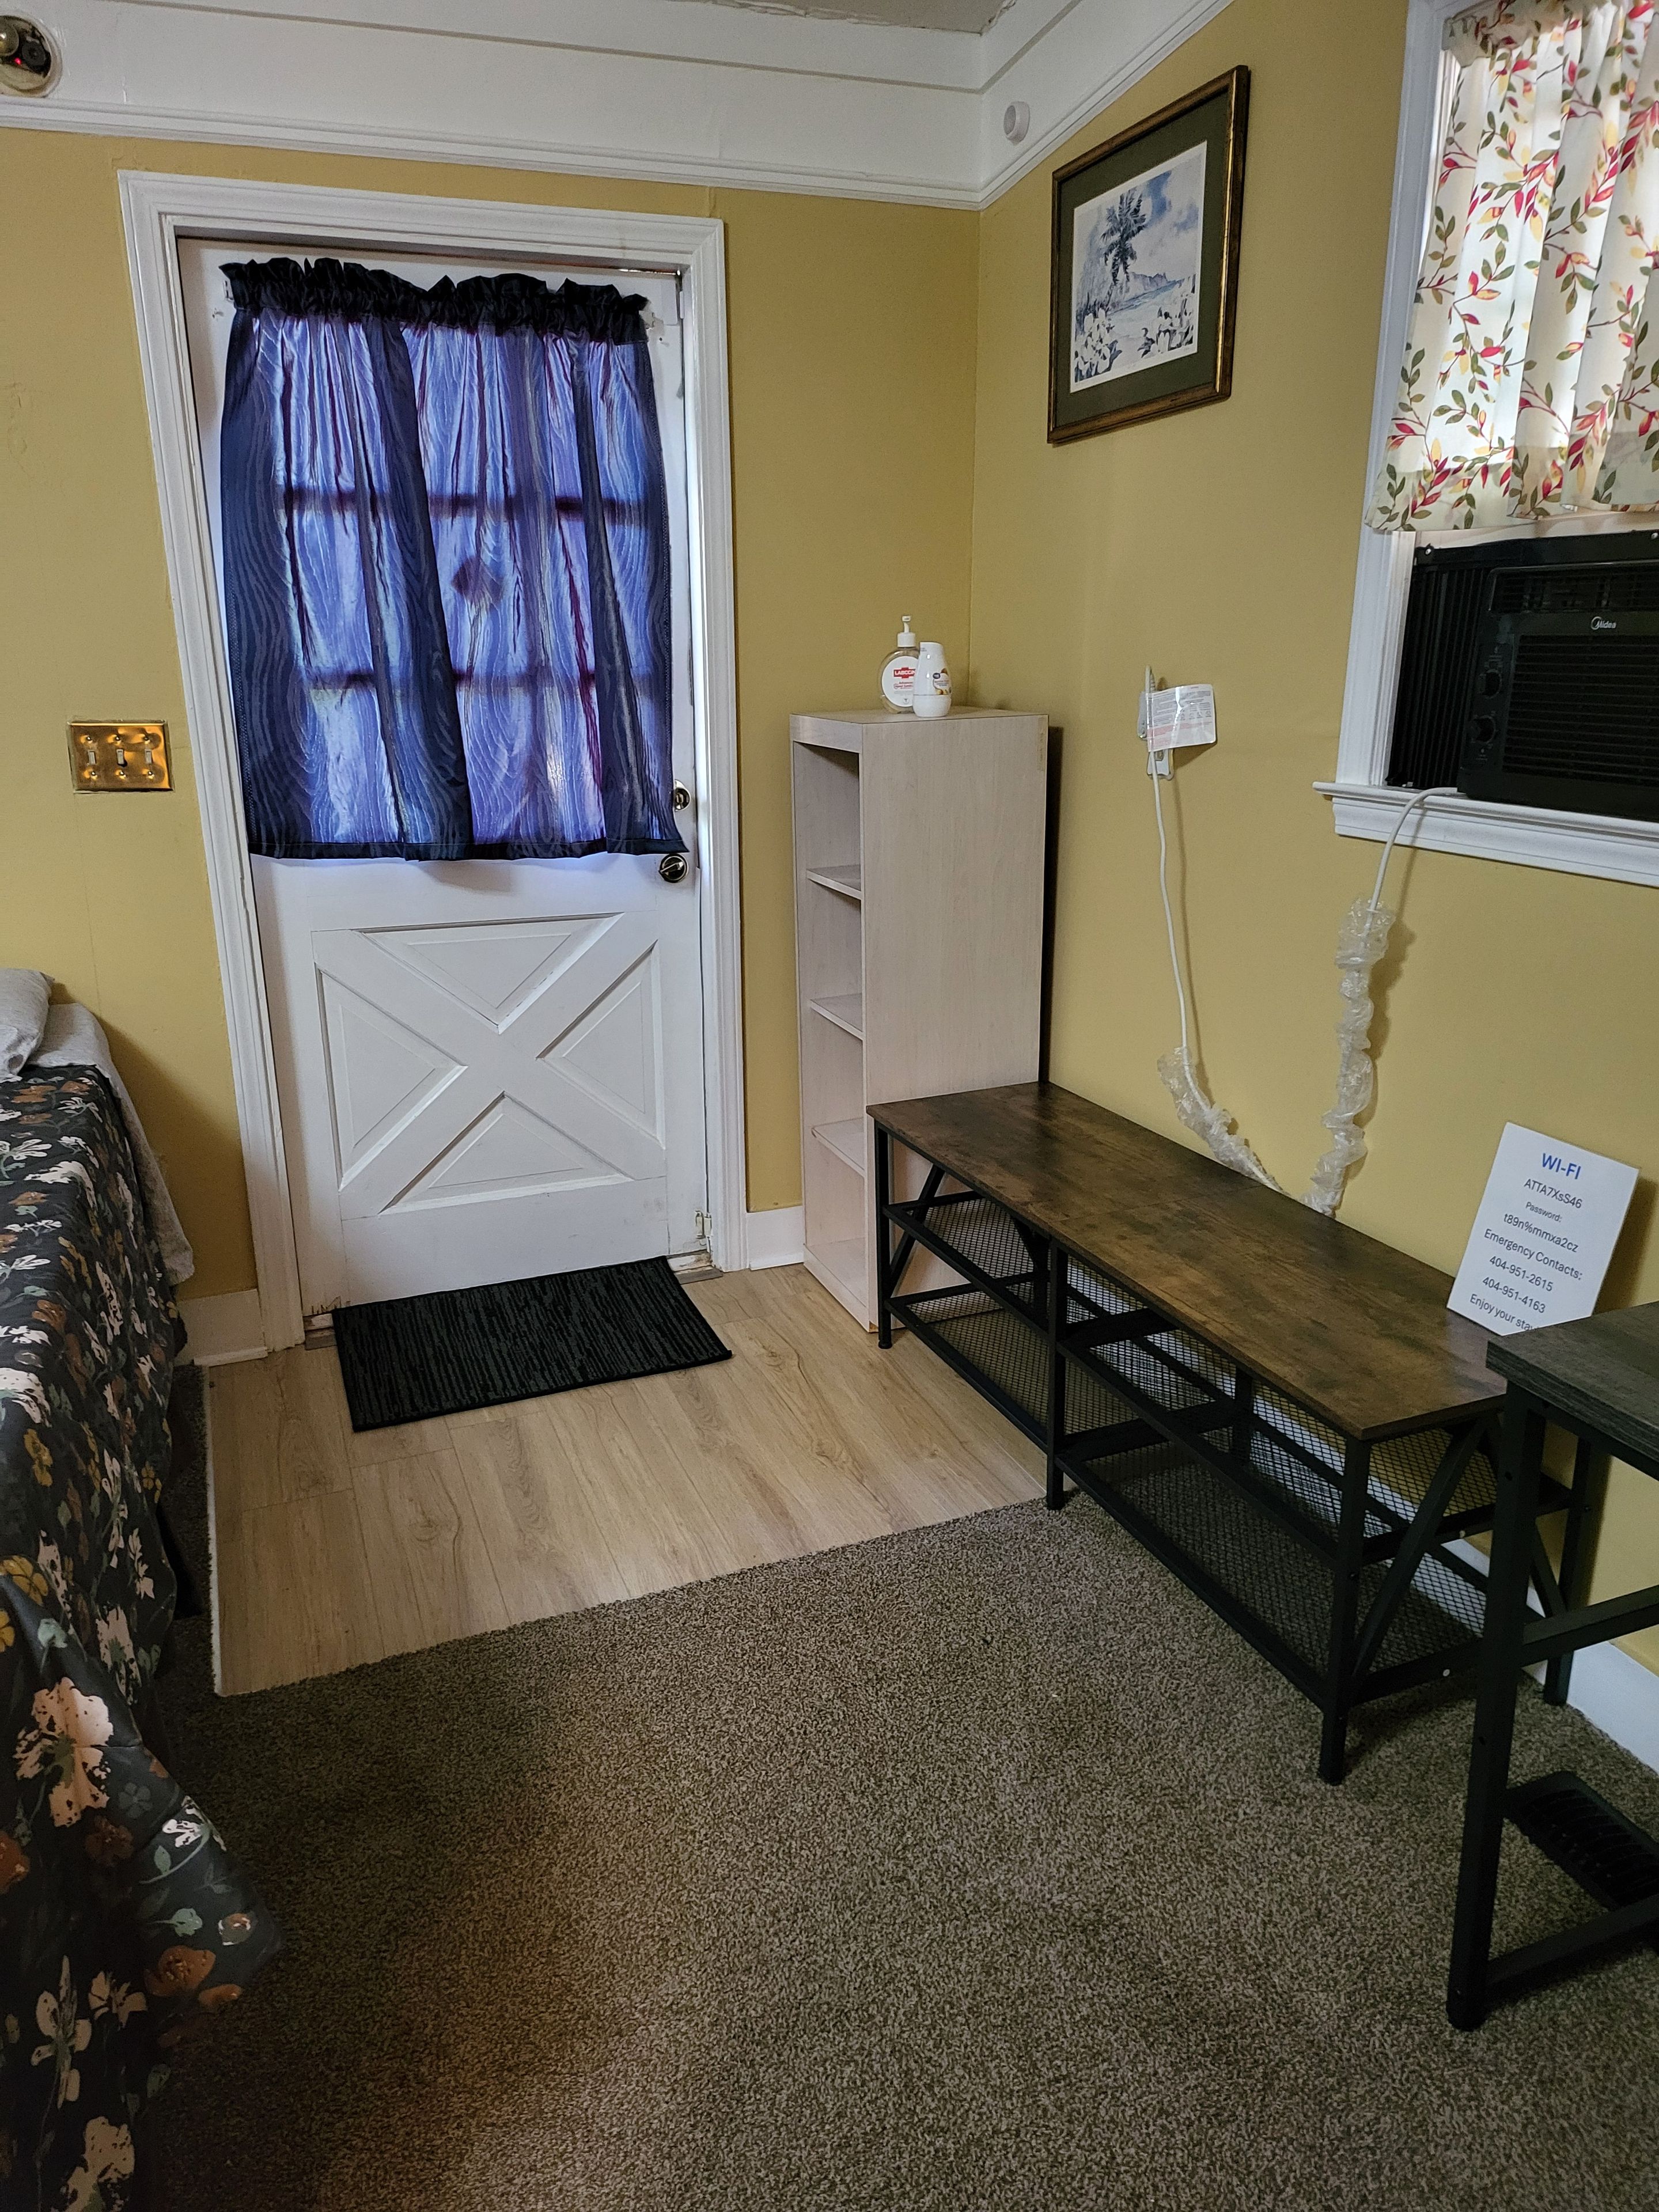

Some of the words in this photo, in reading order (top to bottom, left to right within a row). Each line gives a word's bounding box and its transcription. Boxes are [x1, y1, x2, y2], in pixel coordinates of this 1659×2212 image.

[1591, 616, 1616, 630] Midea
[1542, 1153, 1581, 1180] WI-FI
[1524, 1179, 1583, 1209] ATTA7XsS46
[1525, 1202, 1562, 1222] Password:
[1503, 1213, 1579, 1252] t89n%mmxa2cz
[1484, 1228, 1535, 1259] Emergency
[1535, 1251, 1583, 1280] Contacts:
[1489, 1256, 1554, 1291] 404-951-2615
[1469, 1293, 1495, 1314] Enjoy
[1494, 1308, 1516, 1323] your
[1482, 1277, 1546, 1313] 404-951-4163
